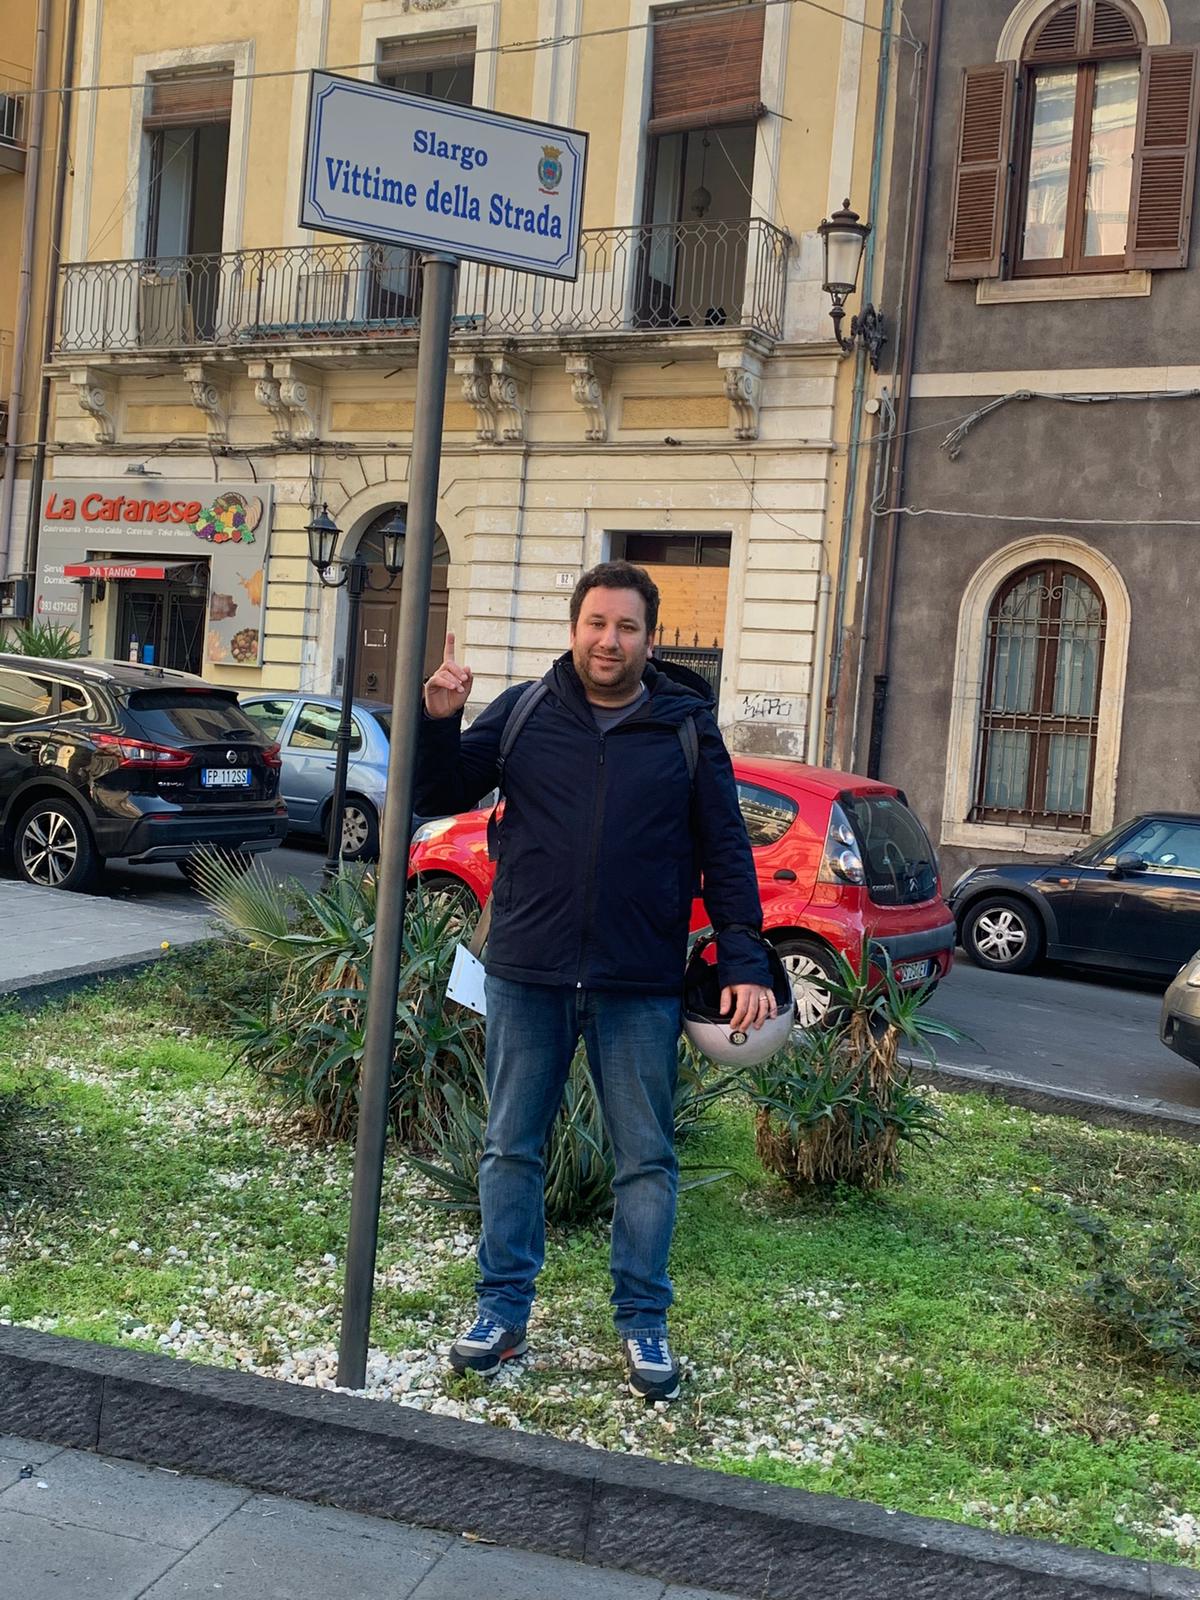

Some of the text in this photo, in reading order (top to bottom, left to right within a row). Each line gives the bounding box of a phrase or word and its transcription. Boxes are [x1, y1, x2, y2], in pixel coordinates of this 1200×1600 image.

[413, 129, 488, 170] Slargo
[326, 157, 562, 239] Vittime della Strada
[45, 492, 202, 524] La Catanese
[89, 567, 137, 577] DA TANINO
[207, 770, 247, 783] FP 112SS
